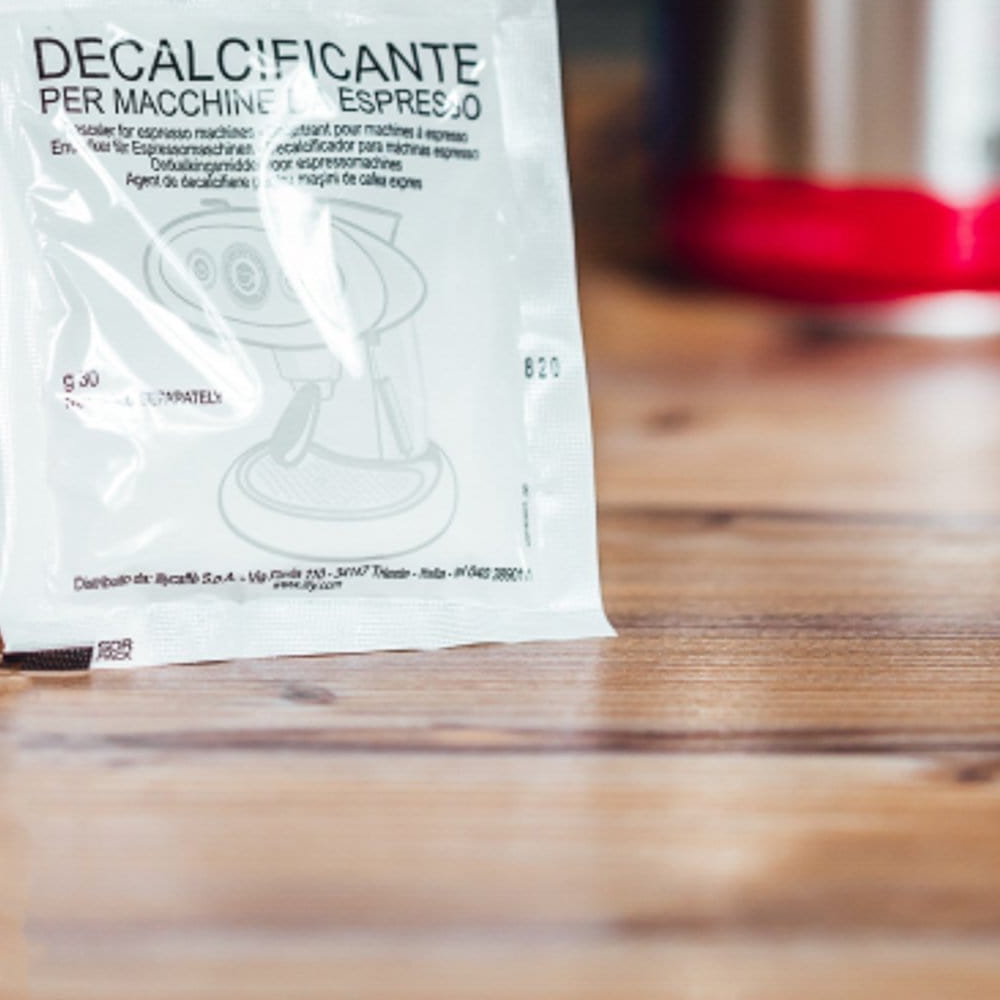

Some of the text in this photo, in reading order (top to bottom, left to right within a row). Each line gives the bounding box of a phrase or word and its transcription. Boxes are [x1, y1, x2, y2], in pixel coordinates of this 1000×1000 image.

[33, 36, 480, 87] DECALCIFICANTE
[39, 86, 105, 115] PER
[113, 88, 276, 118] MACCHINE
[333, 123, 362, 138] pour
[276, 138, 355, 155] ecalcificador
[358, 139, 384, 155] para
